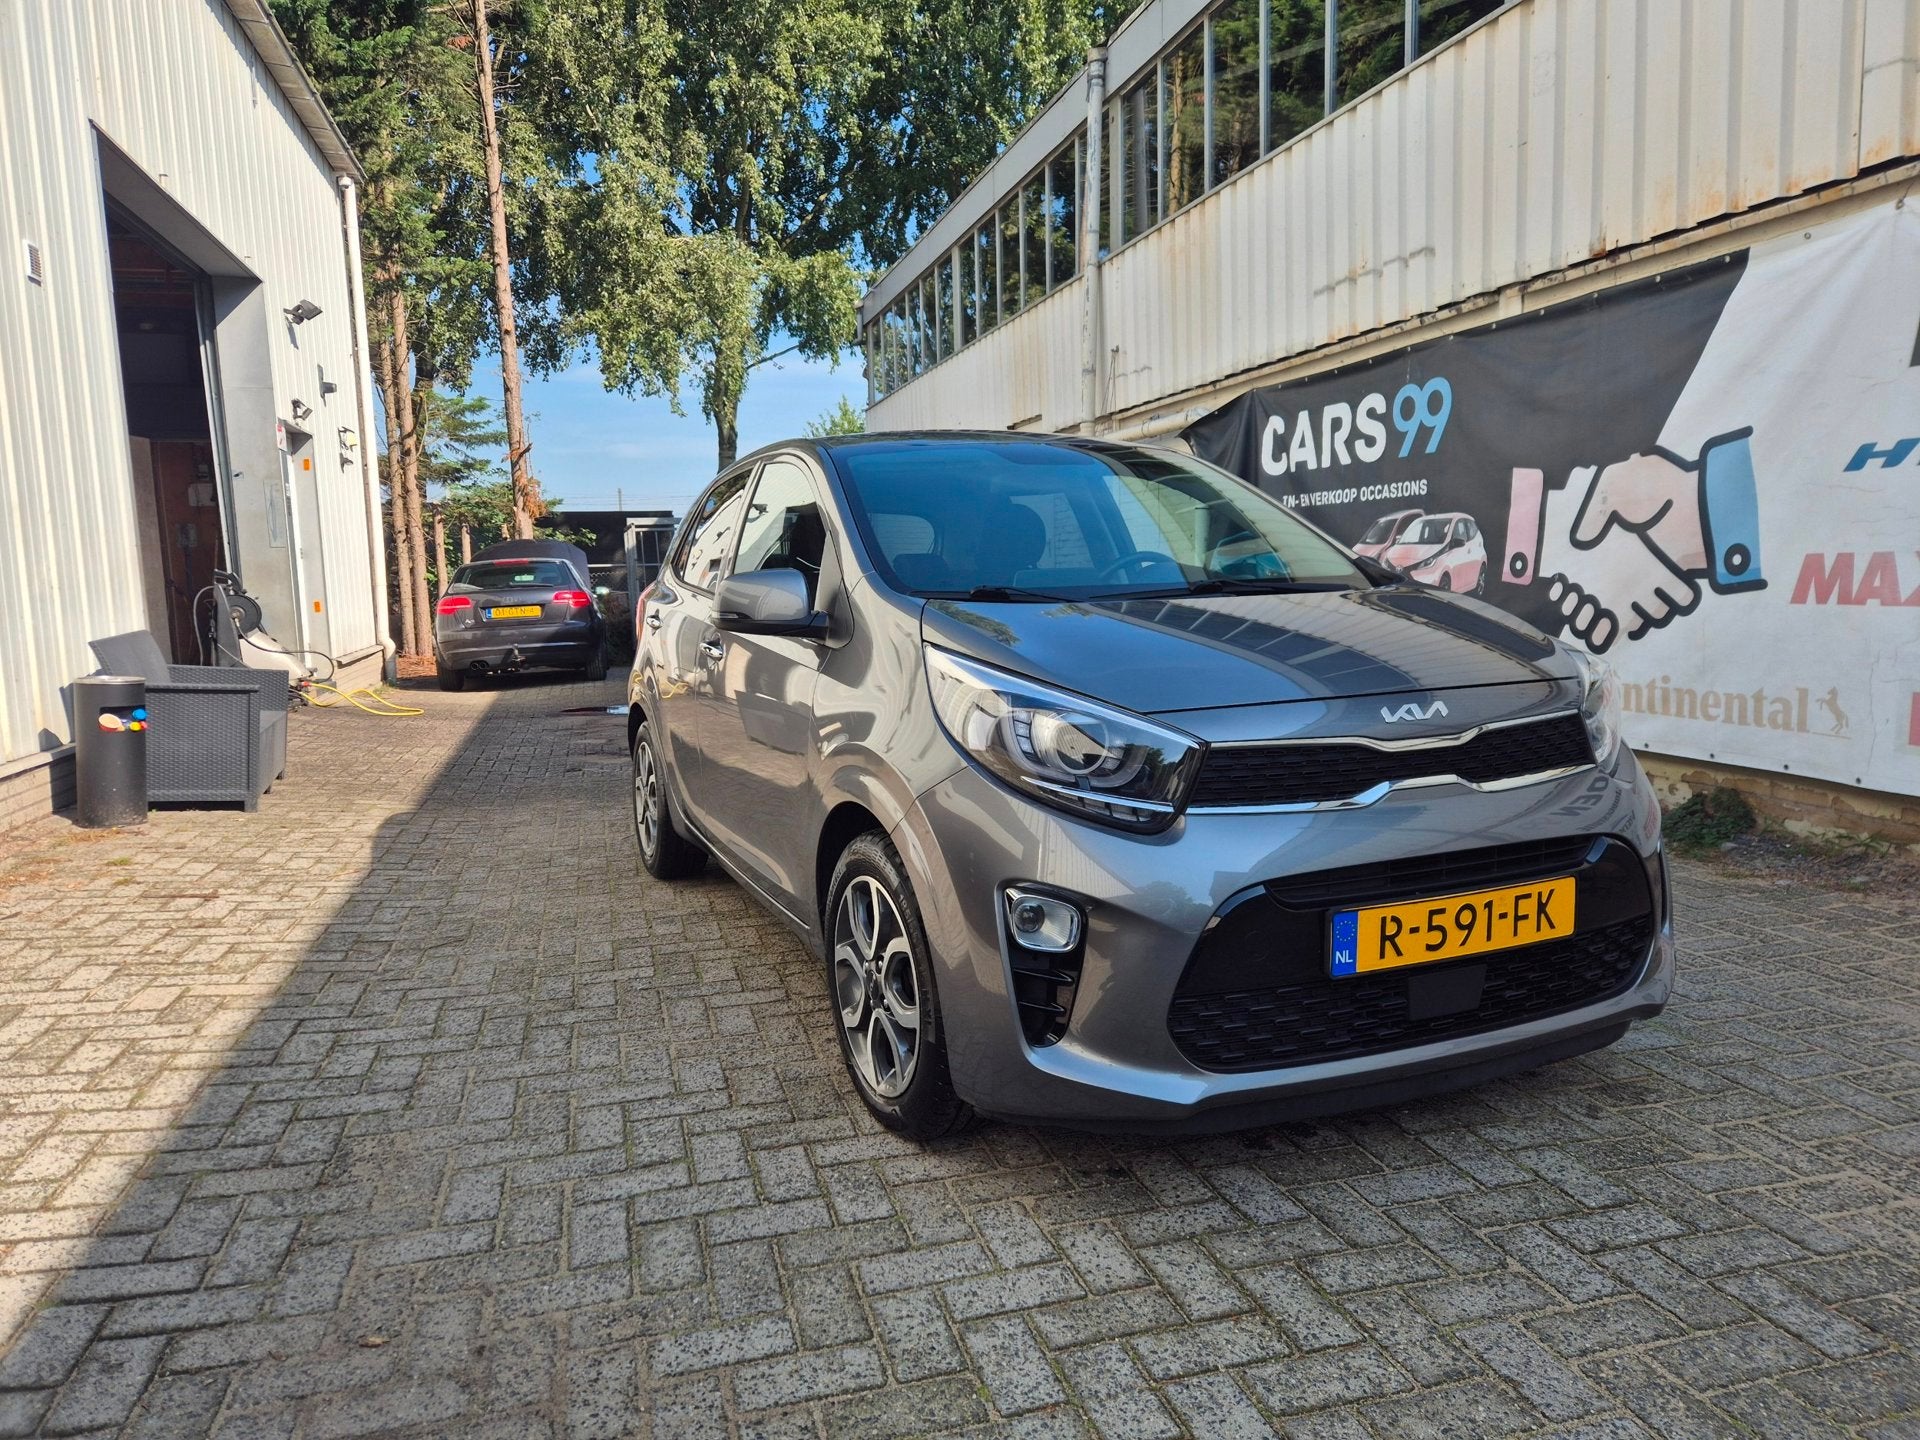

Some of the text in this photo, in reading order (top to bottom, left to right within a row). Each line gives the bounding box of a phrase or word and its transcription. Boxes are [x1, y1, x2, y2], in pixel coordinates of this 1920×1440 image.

[1843, 437, 1920, 472] H
[1309, 487, 1358, 506] VERKOOP
[1360, 479, 1428, 501] OCCASIONS
[1380, 701, 1449, 723] KIA
[1621, 675, 1810, 733] ntinental
[1379, 888, 1556, 960] R-591-FK
[1335, 950, 1353, 964] NL
